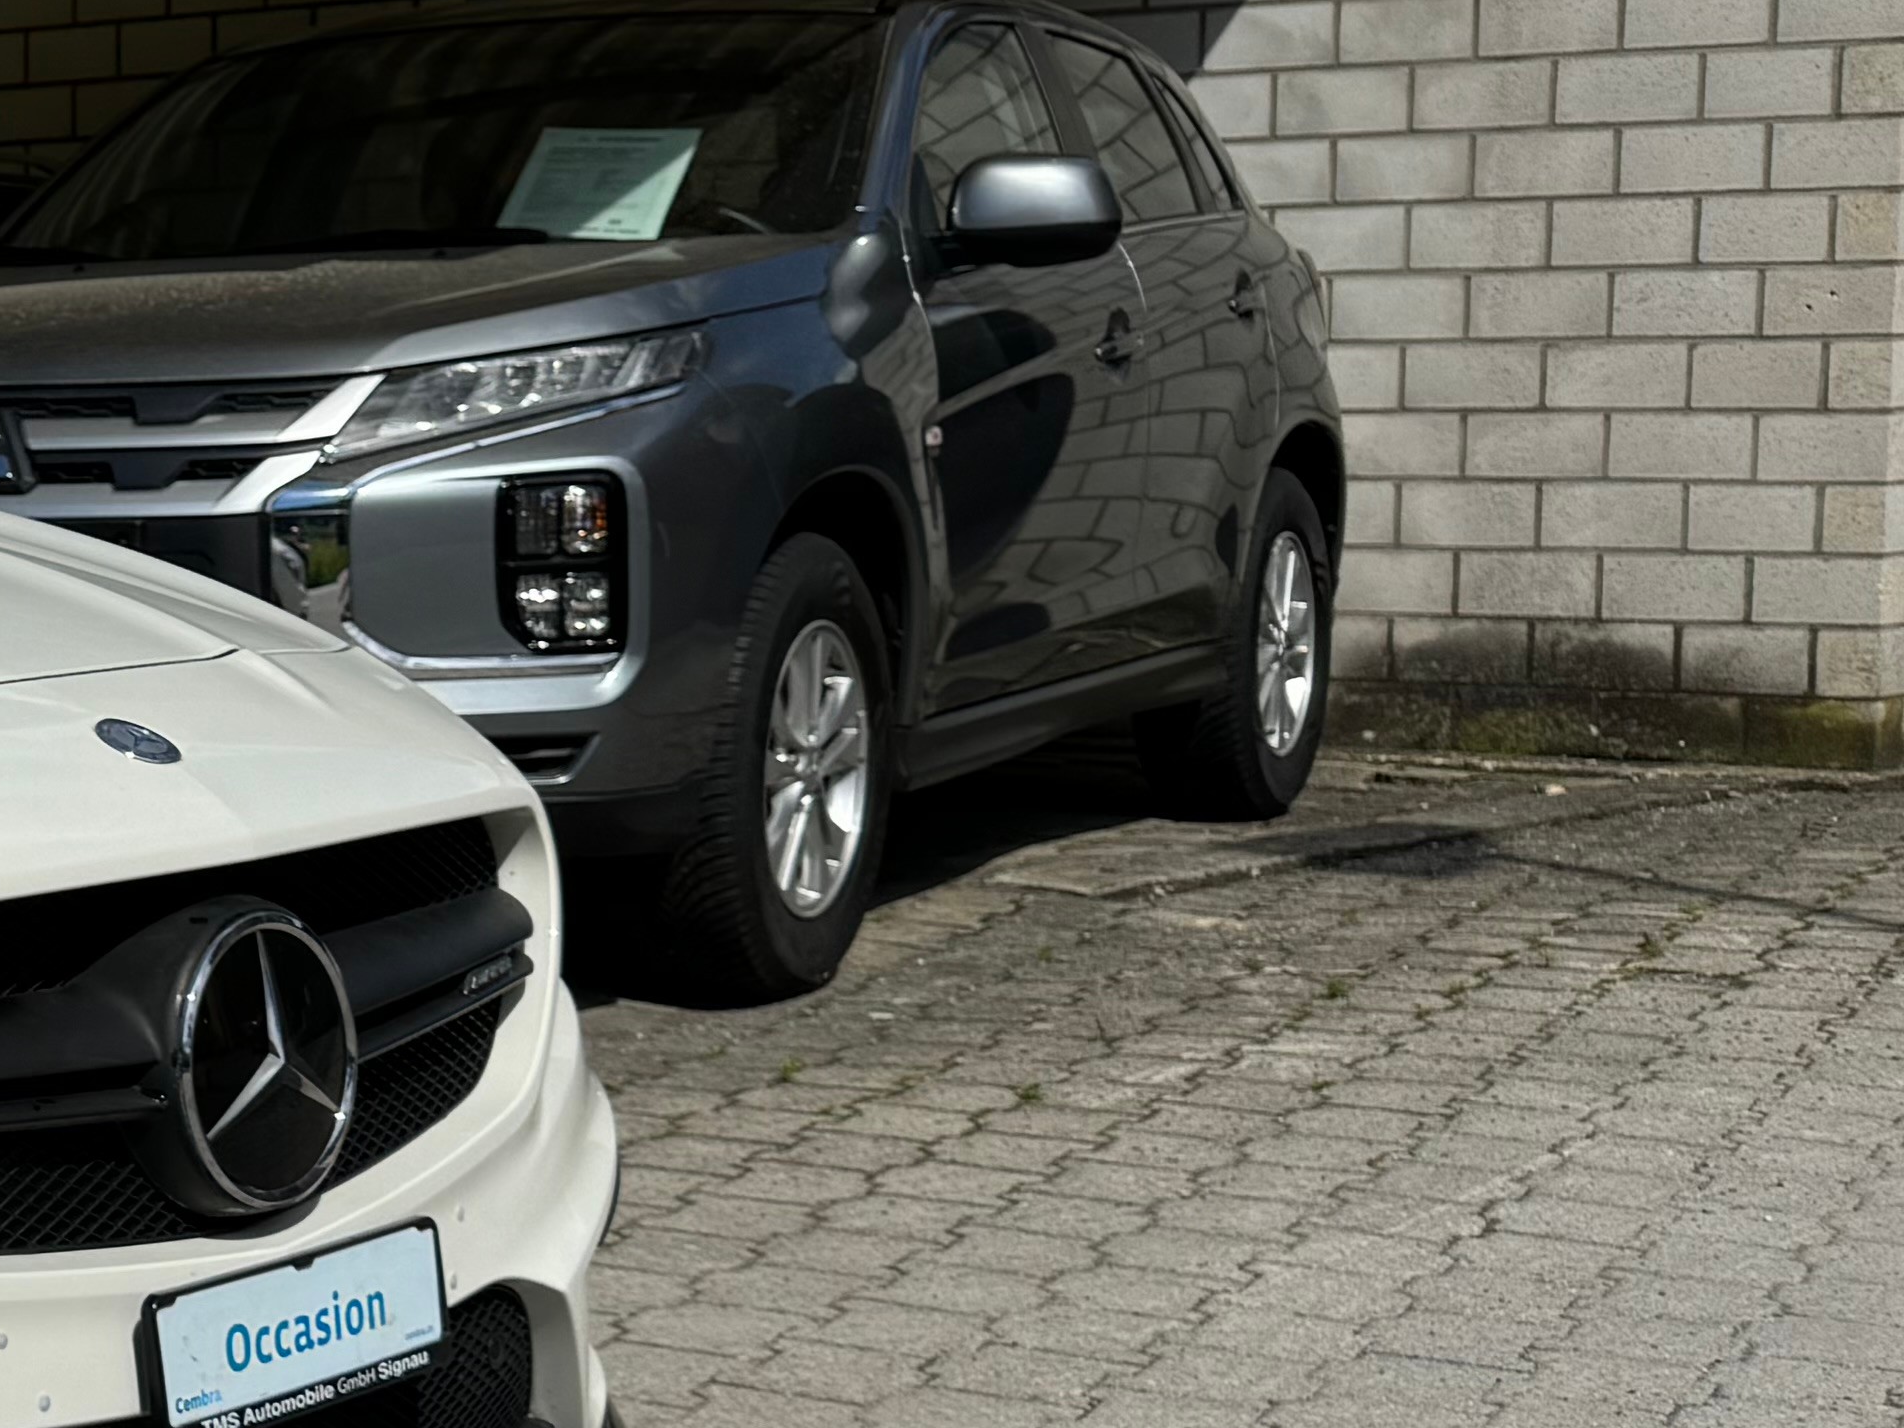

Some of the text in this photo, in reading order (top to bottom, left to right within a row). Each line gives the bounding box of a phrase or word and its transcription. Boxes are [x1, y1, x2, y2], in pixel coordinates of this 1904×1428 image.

[225, 1290, 386, 1373] Occasion
[174, 1387, 223, 1415] Cembra
[243, 1384, 336, 1428] Automobile
[337, 1368, 377, 1395] GmbH
[377, 1349, 430, 1382] Signau
